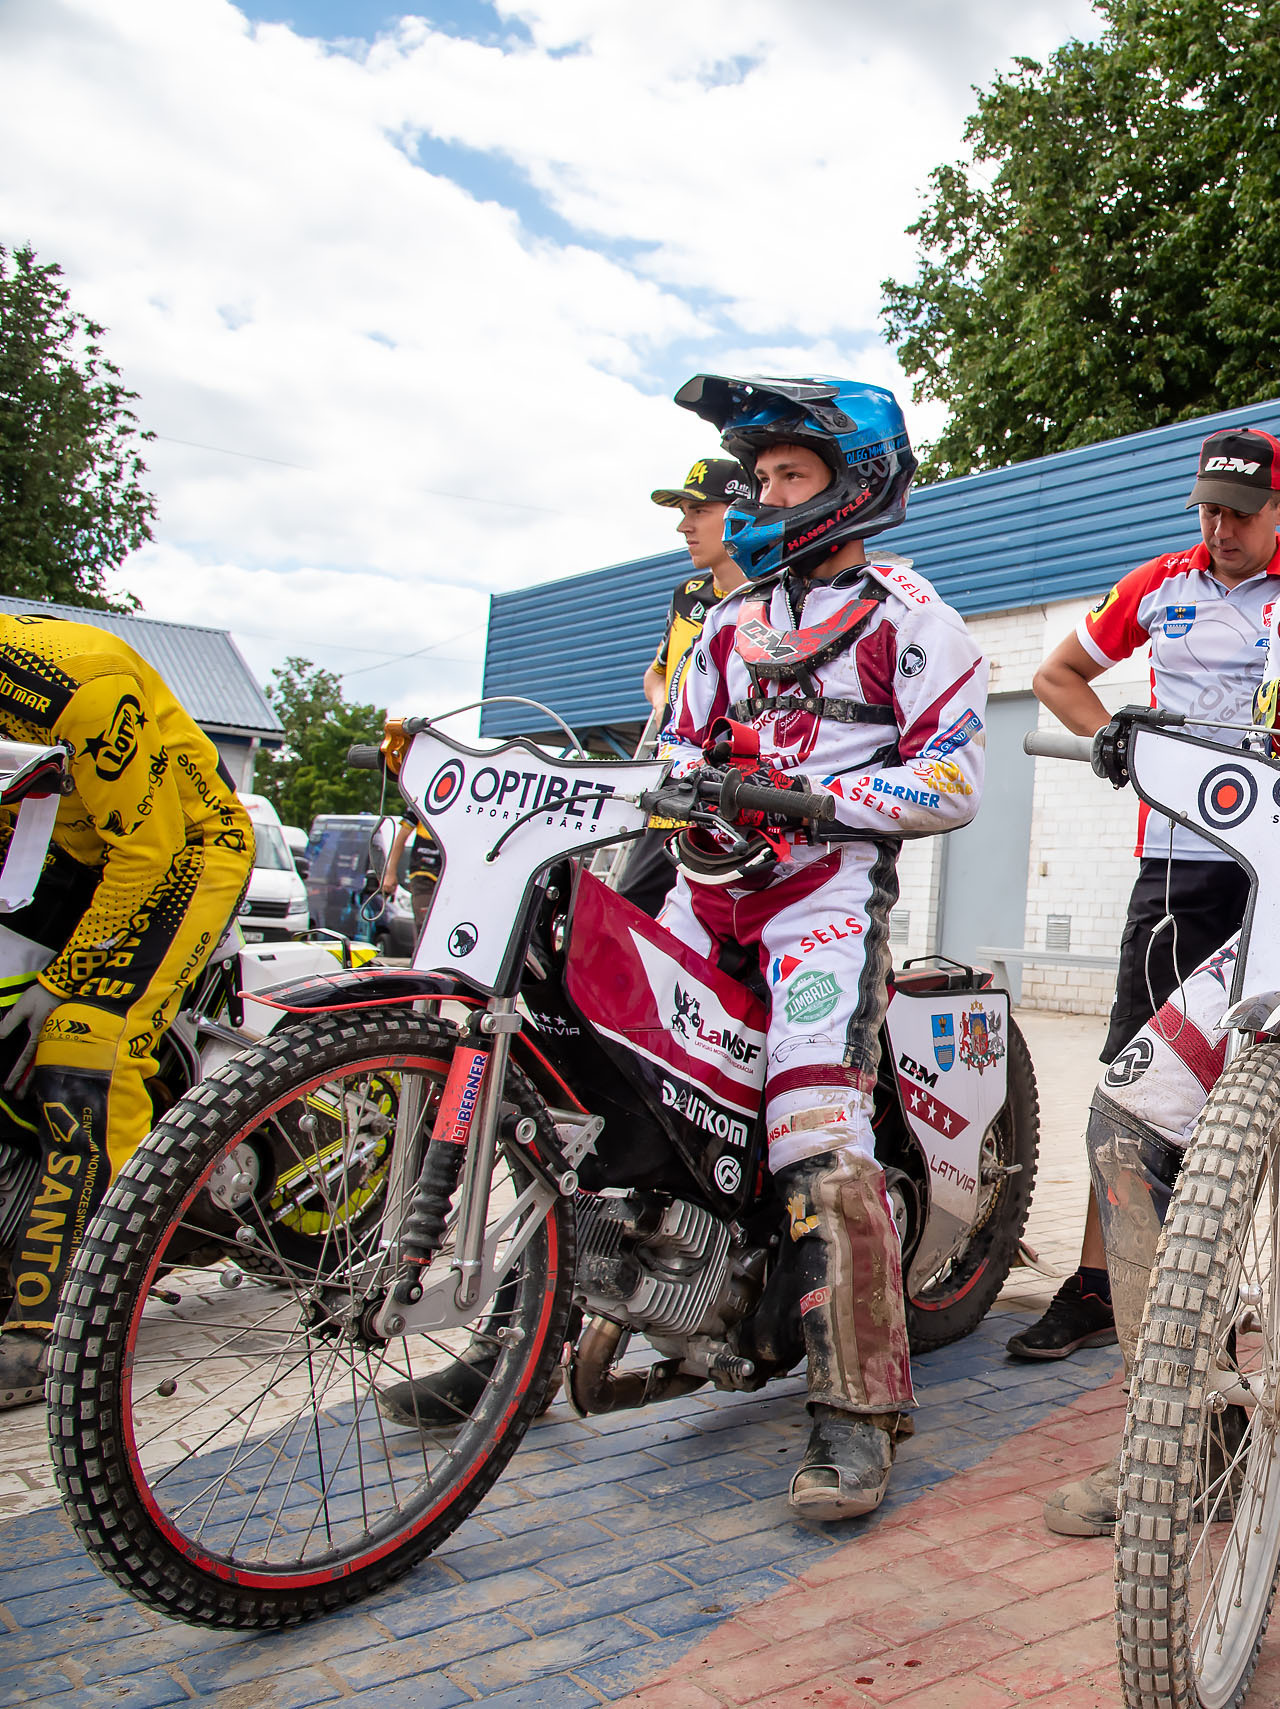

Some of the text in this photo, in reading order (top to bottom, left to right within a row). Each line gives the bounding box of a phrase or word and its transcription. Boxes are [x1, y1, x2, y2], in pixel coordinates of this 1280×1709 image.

[893, 574, 931, 606] SELS
[470, 766, 616, 820] OPTIBET
[849, 786, 902, 820] SELS
[872, 777, 941, 809] BERNER
[546, 816, 597, 834] BĀRS
[800, 917, 863, 953] SELS
[788, 979, 835, 1016] LIMBAŽU
[539, 1021, 581, 1036] ATVIA
[457, 1054, 489, 1123] BERNER
[662, 1079, 749, 1148] DAUTKOM
[930, 1154, 976, 1195] LATVIA
[72, 1154, 99, 1246] NOWOCZESNYCH
[16, 1151, 82, 1307] SANTO
